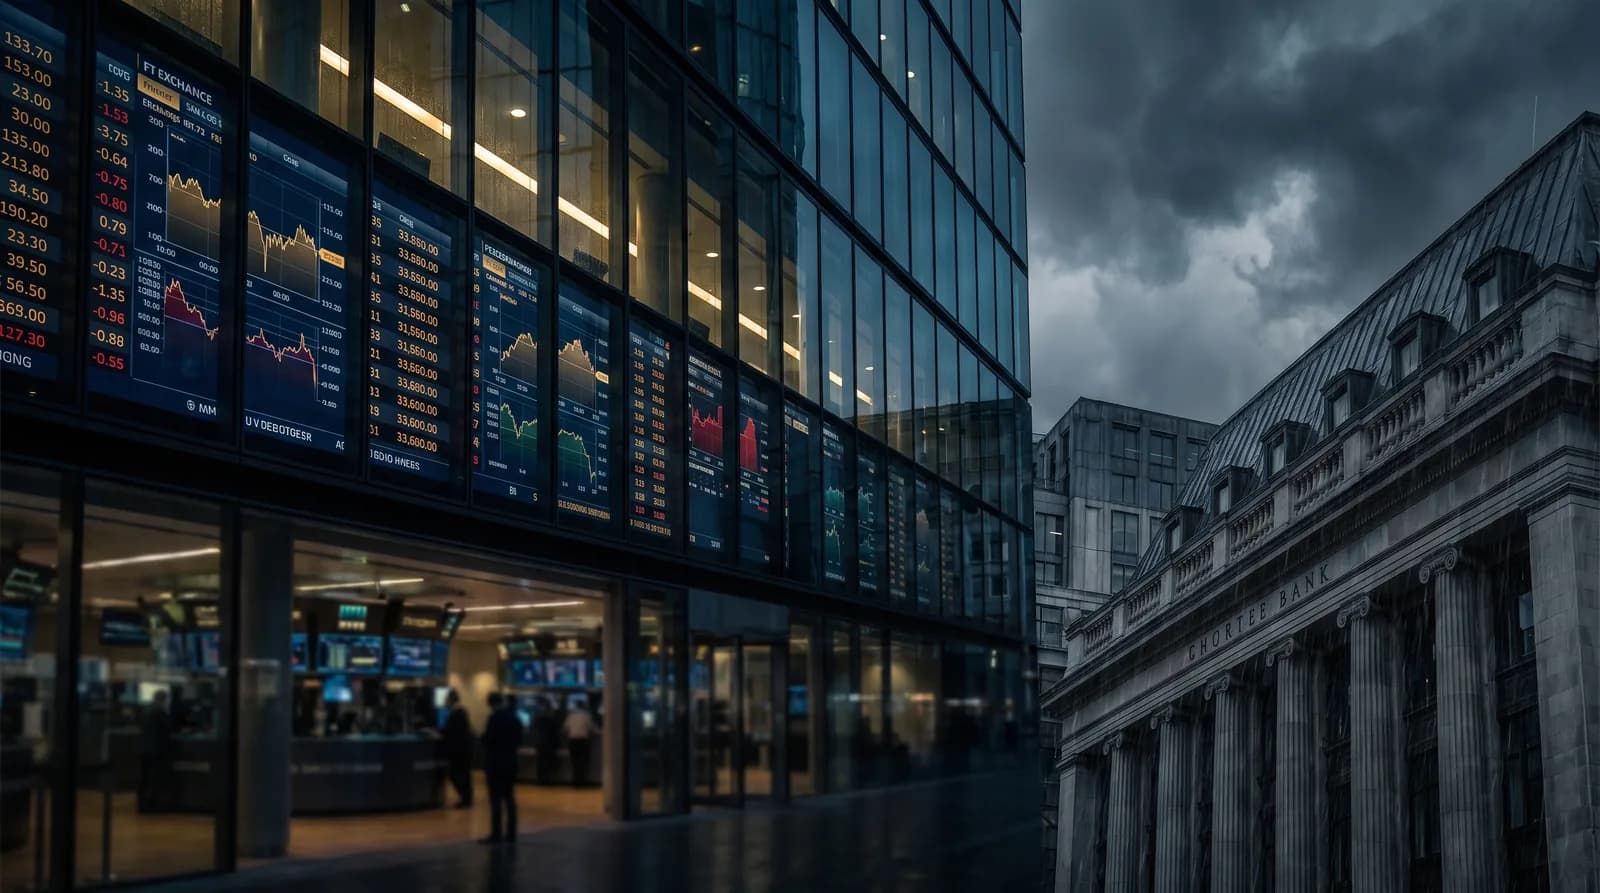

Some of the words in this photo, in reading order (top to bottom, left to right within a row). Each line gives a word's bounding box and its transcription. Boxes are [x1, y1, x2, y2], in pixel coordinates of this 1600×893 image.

[4, 32, 52, 64] 133.70
[4, 56, 51, 87] 153.00
[143, 60, 157, 75] FT
[158, 68, 213, 106] EXCHANGE
[11, 83, 51, 111] 23.00
[97, 81, 130, 103] -1.35
[11, 107, 50, 134] 30.00
[98, 103, 130, 125] -1.53
[2, 128, 50, 158] 135.00
[97, 124, 129, 147] -3.75
[1, 153, 49, 181] 213.80
[96, 147, 128, 169] -0.64
[9, 179, 49, 205] 34.50
[95, 170, 128, 191] -0.75
[95, 192, 128, 213] -0.80
[0, 201, 48, 228] 190.20
[99, 215, 127, 235] 0.79
[8, 228, 47, 252] 23.30
[7, 253, 47, 277] 39.50
[92, 261, 126, 280] -0.23
[6, 277, 46, 300] 56.50
[92, 284, 125, 302] -1.35
[92, 306, 125, 325] -0.96
[89, 329, 125, 347] -0.88
[92, 352, 125, 370] -0.55
[1279, 563, 1329, 609] BANK
